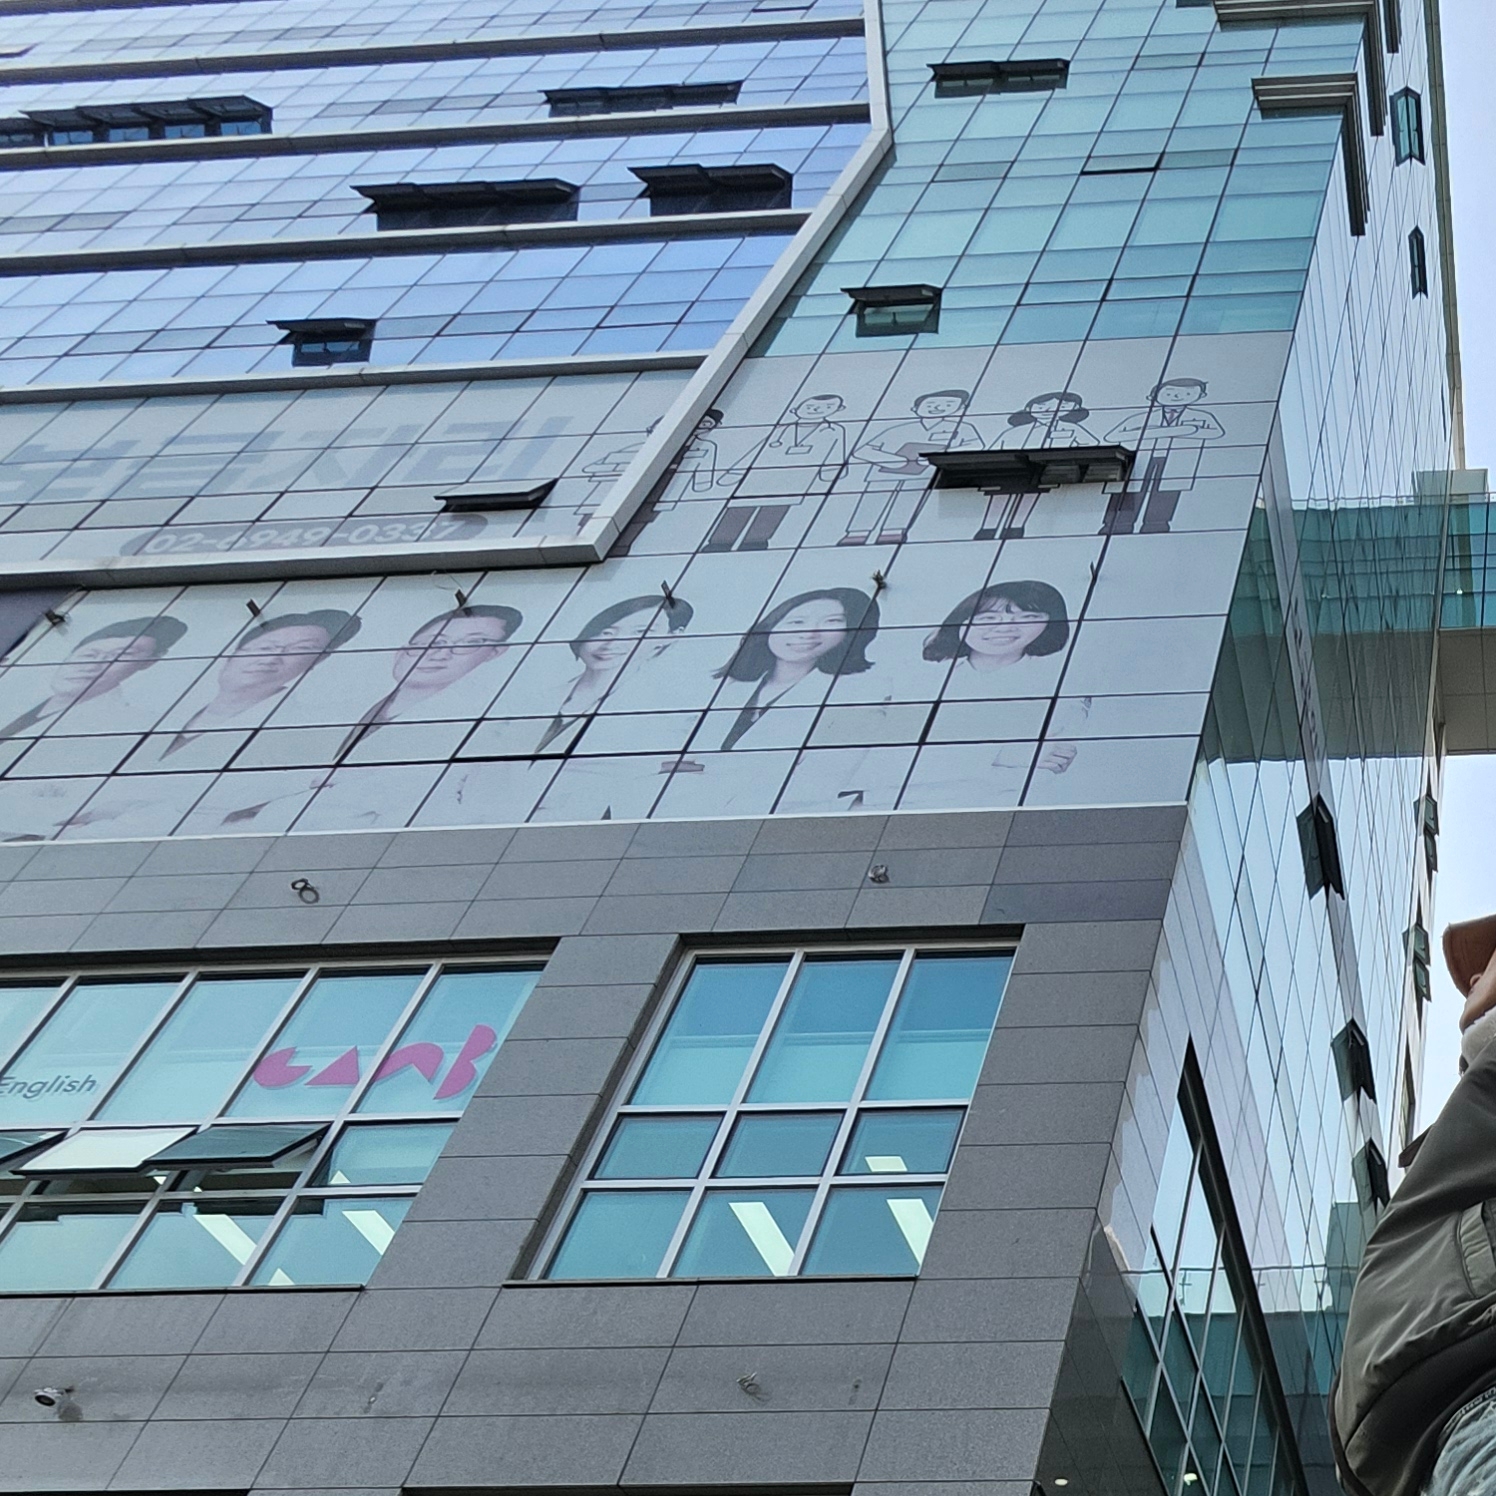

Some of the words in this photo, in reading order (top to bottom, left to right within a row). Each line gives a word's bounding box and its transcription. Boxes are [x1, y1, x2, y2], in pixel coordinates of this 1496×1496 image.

[0, 416, 573, 502] 보금자리
[144, 519, 467, 554] 02-6949-0337
[0, 1075, 97, 1099] English
